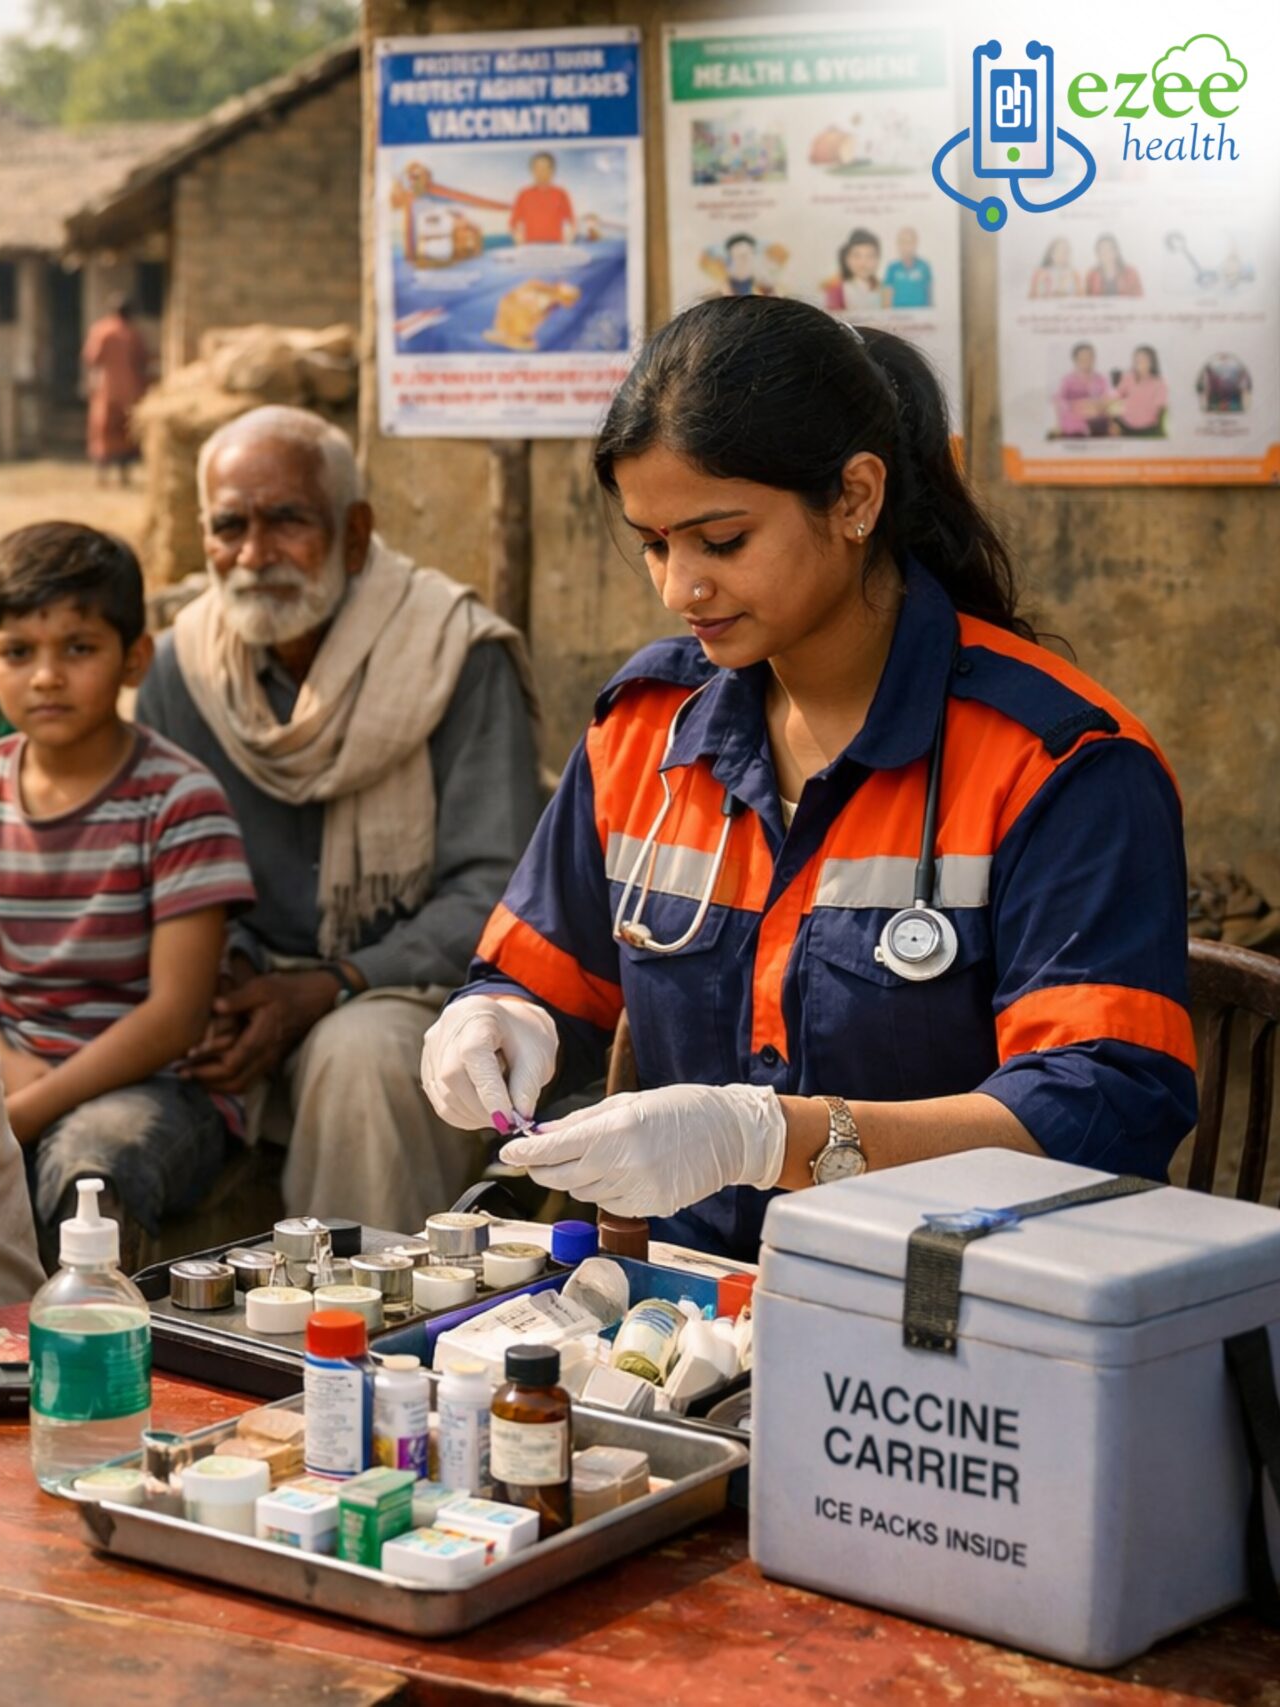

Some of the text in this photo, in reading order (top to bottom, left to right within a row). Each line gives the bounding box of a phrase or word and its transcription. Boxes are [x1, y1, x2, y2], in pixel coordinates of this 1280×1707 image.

[389, 79, 478, 106] PROTECT
[692, 59, 786, 89] HEALTH
[791, 58, 811, 85] &
[426, 105, 590, 138] VACCINATION
[824, 1371, 1020, 1450] VACCINE
[824, 1426, 1020, 1505] CARRIER
[815, 1495, 1028, 1568] ICE PACKS INSIDE
